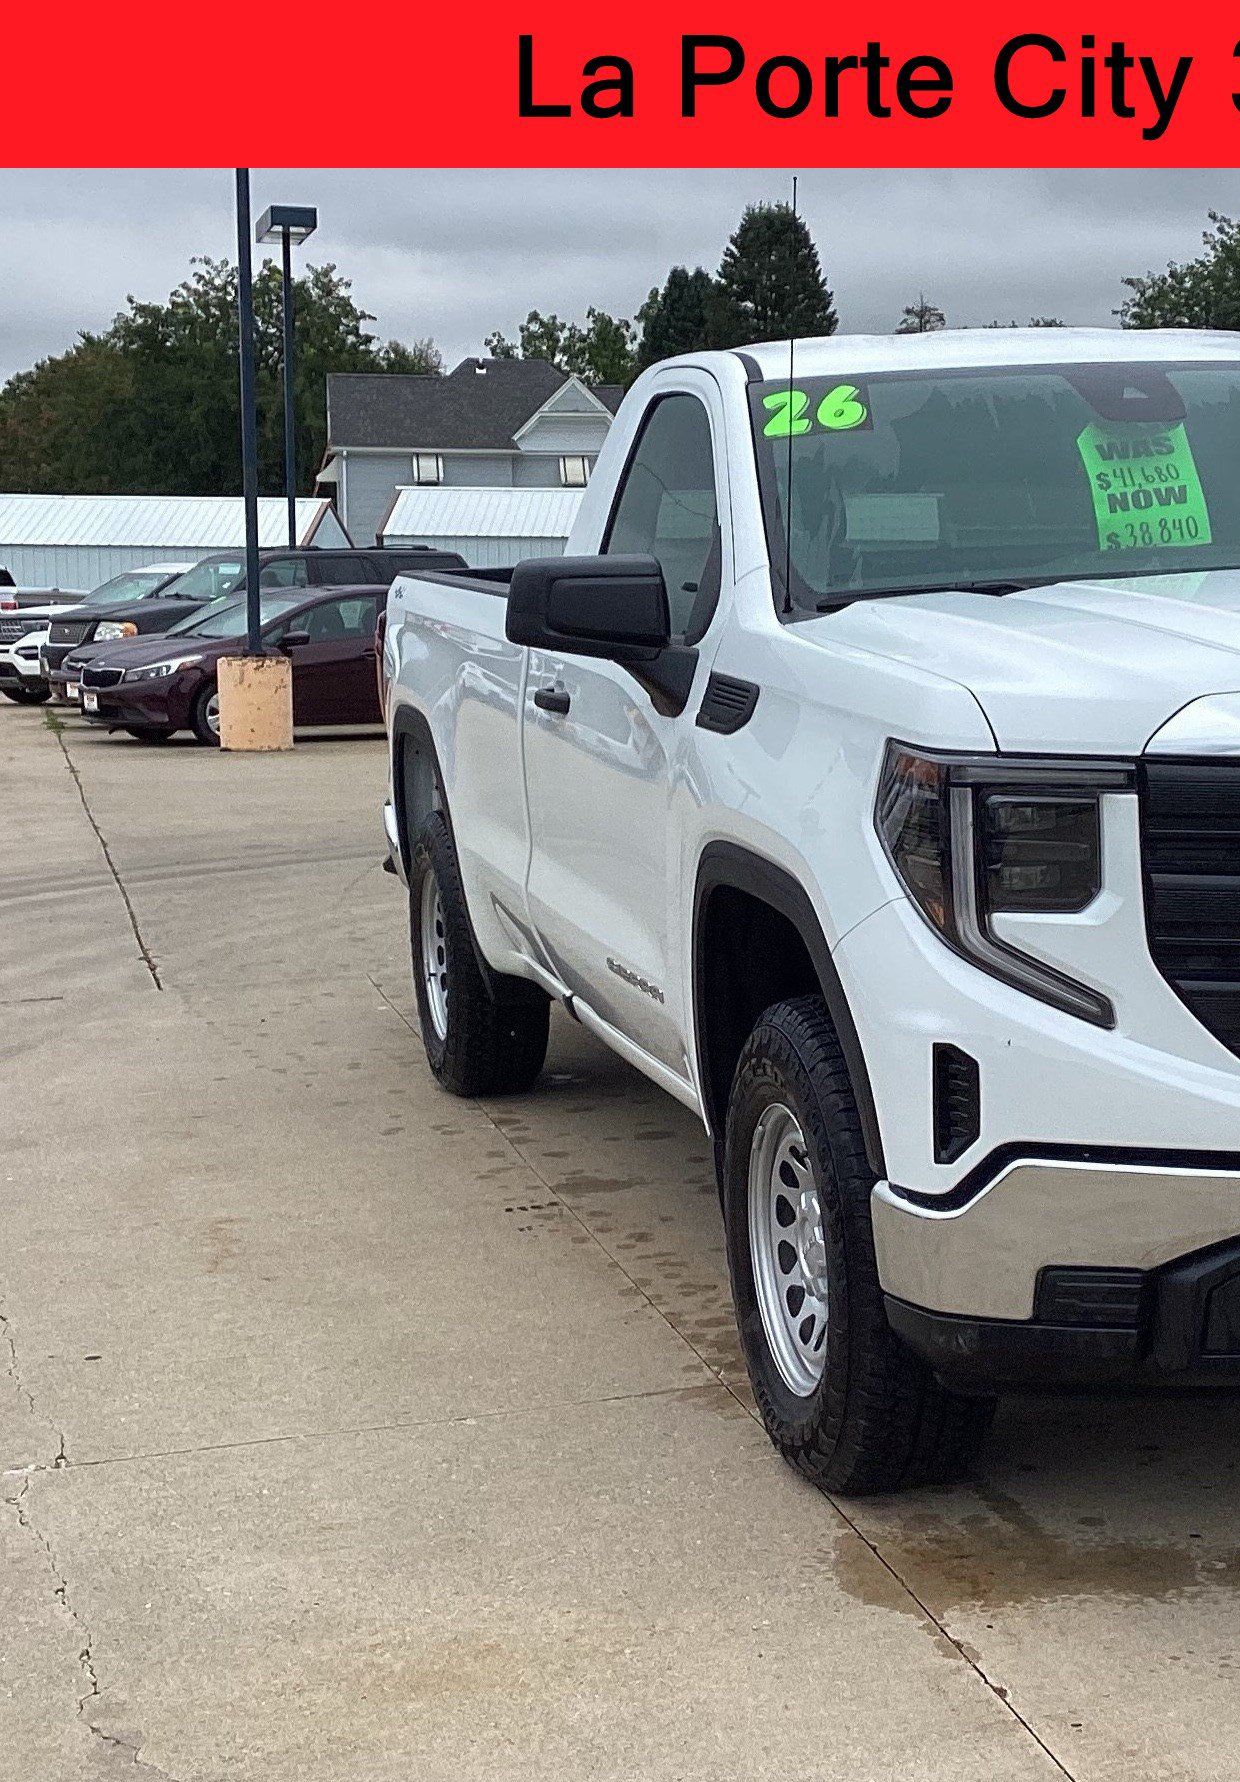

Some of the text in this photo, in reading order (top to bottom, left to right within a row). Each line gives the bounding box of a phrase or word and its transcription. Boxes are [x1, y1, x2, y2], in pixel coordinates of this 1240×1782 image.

[762, 385, 867, 437] 26
[1095, 438, 1175, 460] WAS
[1107, 485, 1187, 513] NOW
